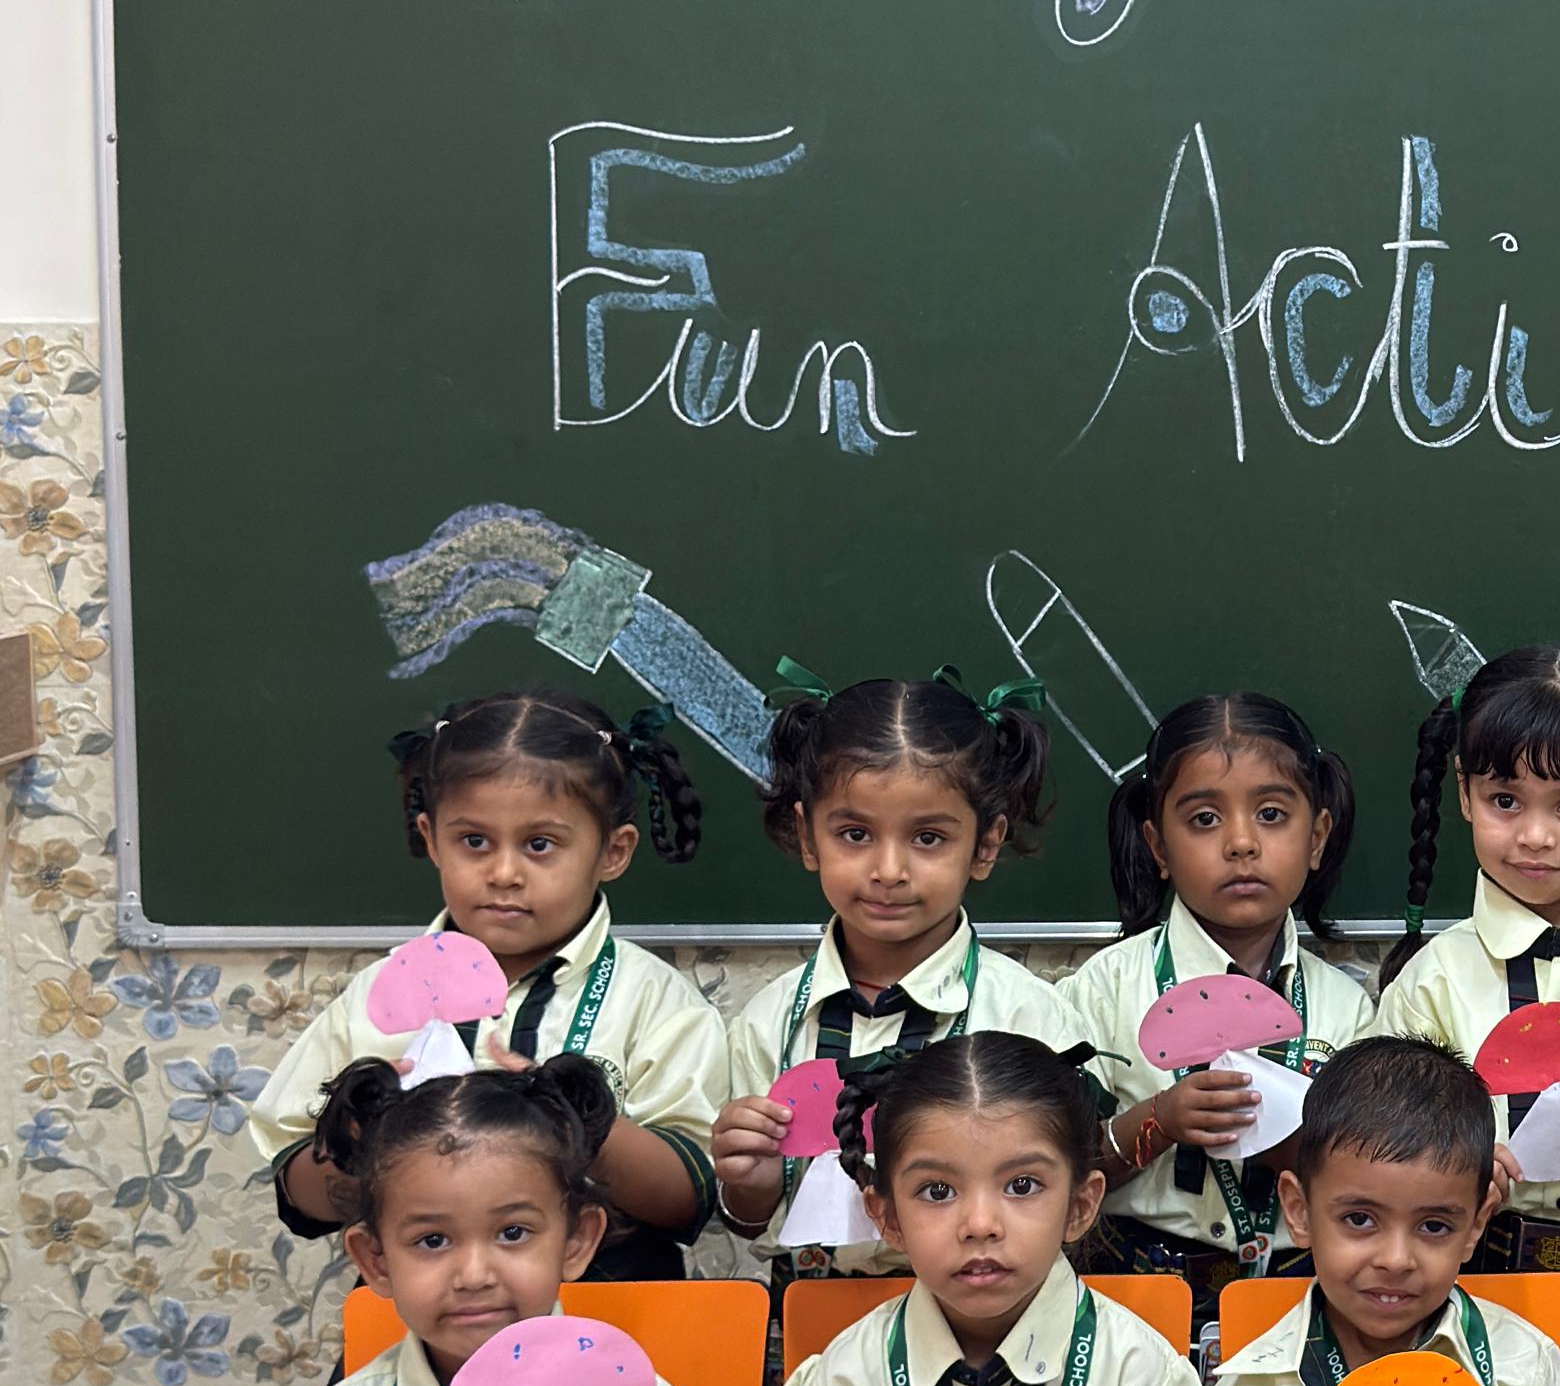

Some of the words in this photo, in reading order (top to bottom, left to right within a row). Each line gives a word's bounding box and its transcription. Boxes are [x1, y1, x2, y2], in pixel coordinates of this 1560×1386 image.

[549, 121, 917, 455] Fun
[589, 958, 614, 1001] SCHOOL
[578, 1003, 599, 1028] SEC.
[572, 1030, 588, 1051] SR.
[1217, 1161, 1245, 1212] JOSEPH
[1238, 1214, 1251, 1234] ST.
[1327, 1346, 1345, 1383] HOOL
